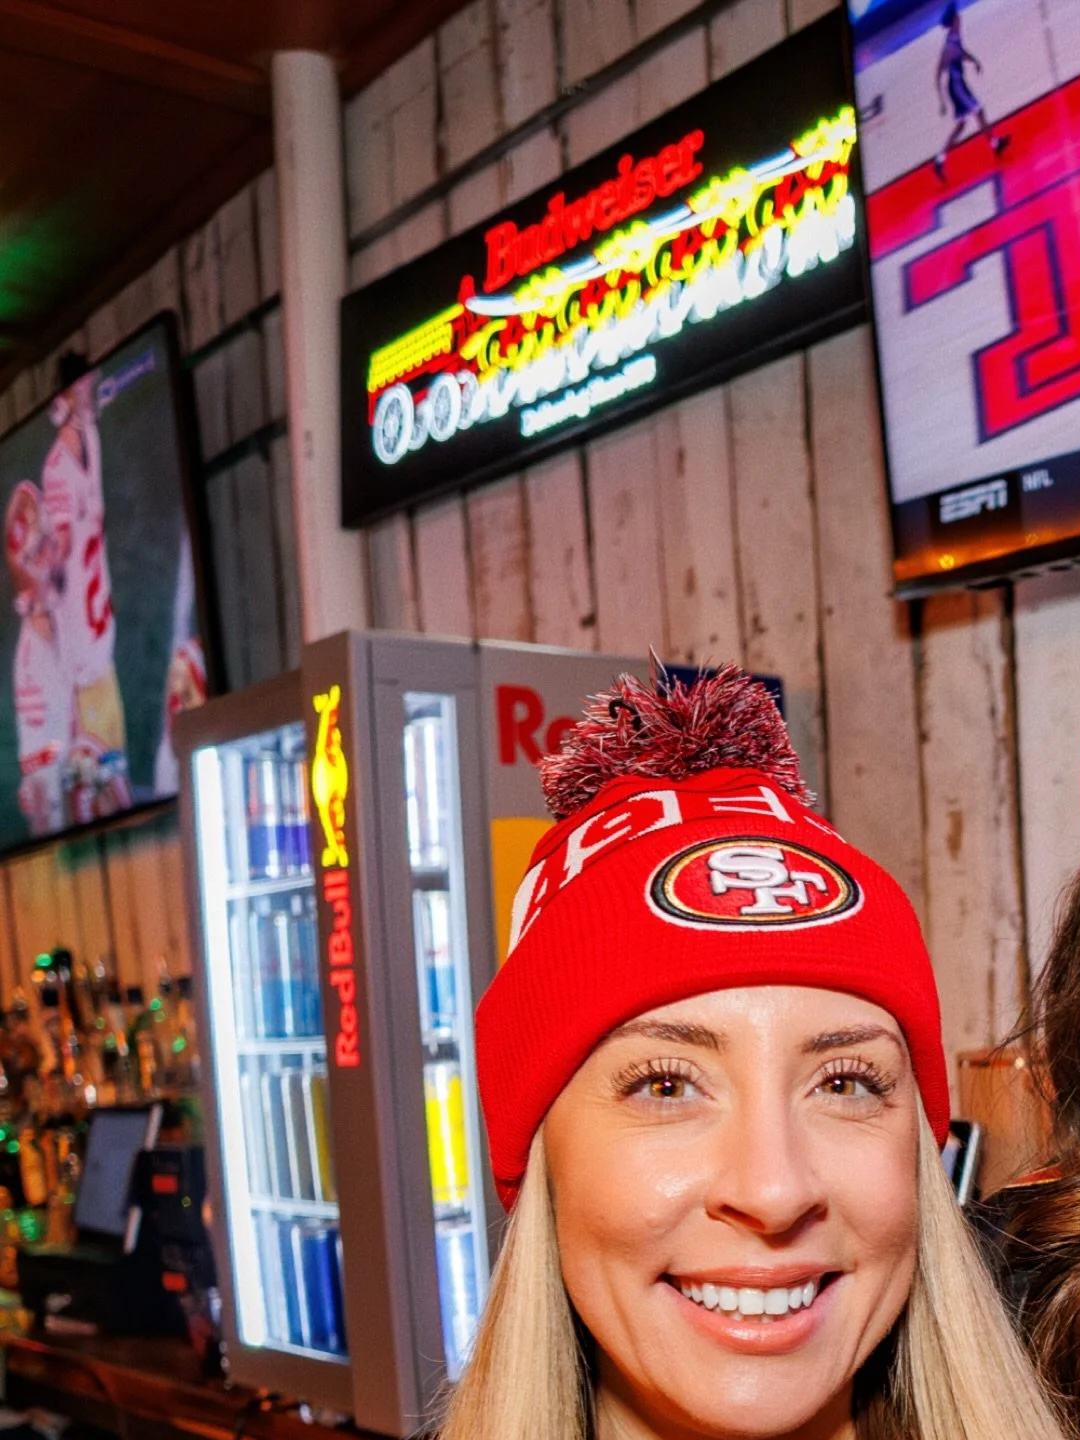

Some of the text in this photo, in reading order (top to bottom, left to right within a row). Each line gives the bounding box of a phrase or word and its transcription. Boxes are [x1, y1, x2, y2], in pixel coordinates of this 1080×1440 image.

[484, 130, 704, 292] Budweiser
[939, 478, 1008, 524] ESPN
[1022, 468, 1053, 492] NFL
